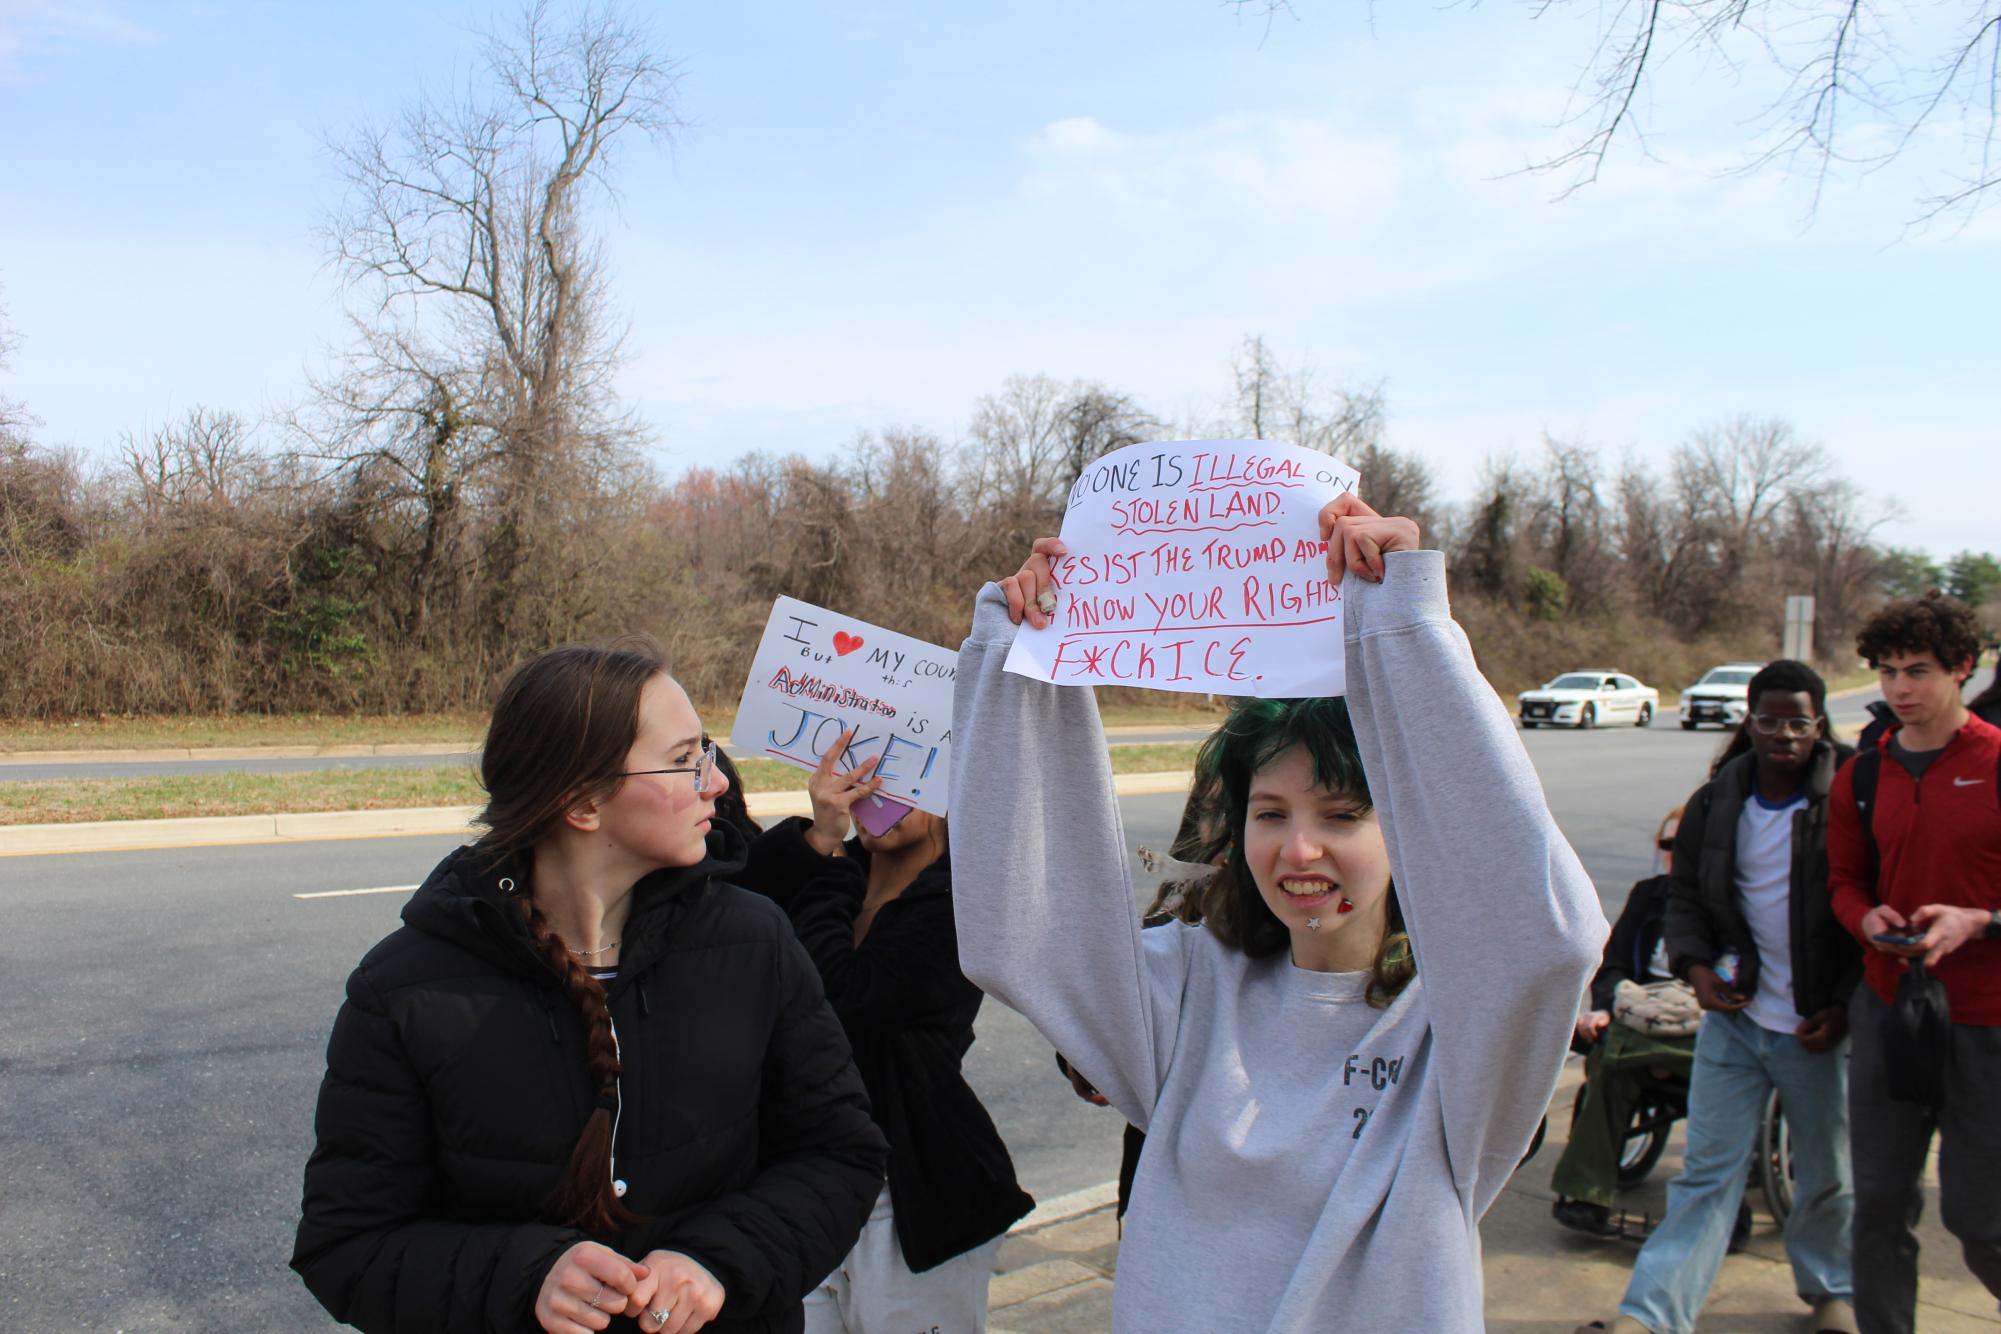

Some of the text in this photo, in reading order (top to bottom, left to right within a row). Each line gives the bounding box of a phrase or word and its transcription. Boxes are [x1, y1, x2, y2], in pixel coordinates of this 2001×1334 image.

[1092, 459, 1141, 493] ONE
[1151, 453, 1183, 487] IS
[1188, 453, 1306, 488] ILLEGAL
[1315, 470, 1354, 492] ON
[1110, 491, 1285, 529] STOLEN LAND.
[1150, 542, 1195, 576] THE
[1202, 537, 1286, 570] TRUMP
[1067, 592, 1135, 630] KNOW
[1144, 586, 1227, 636] YOUR
[783, 616, 819, 645] I
[865, 647, 905, 673] MY
[939, 729, 952, 745] A
